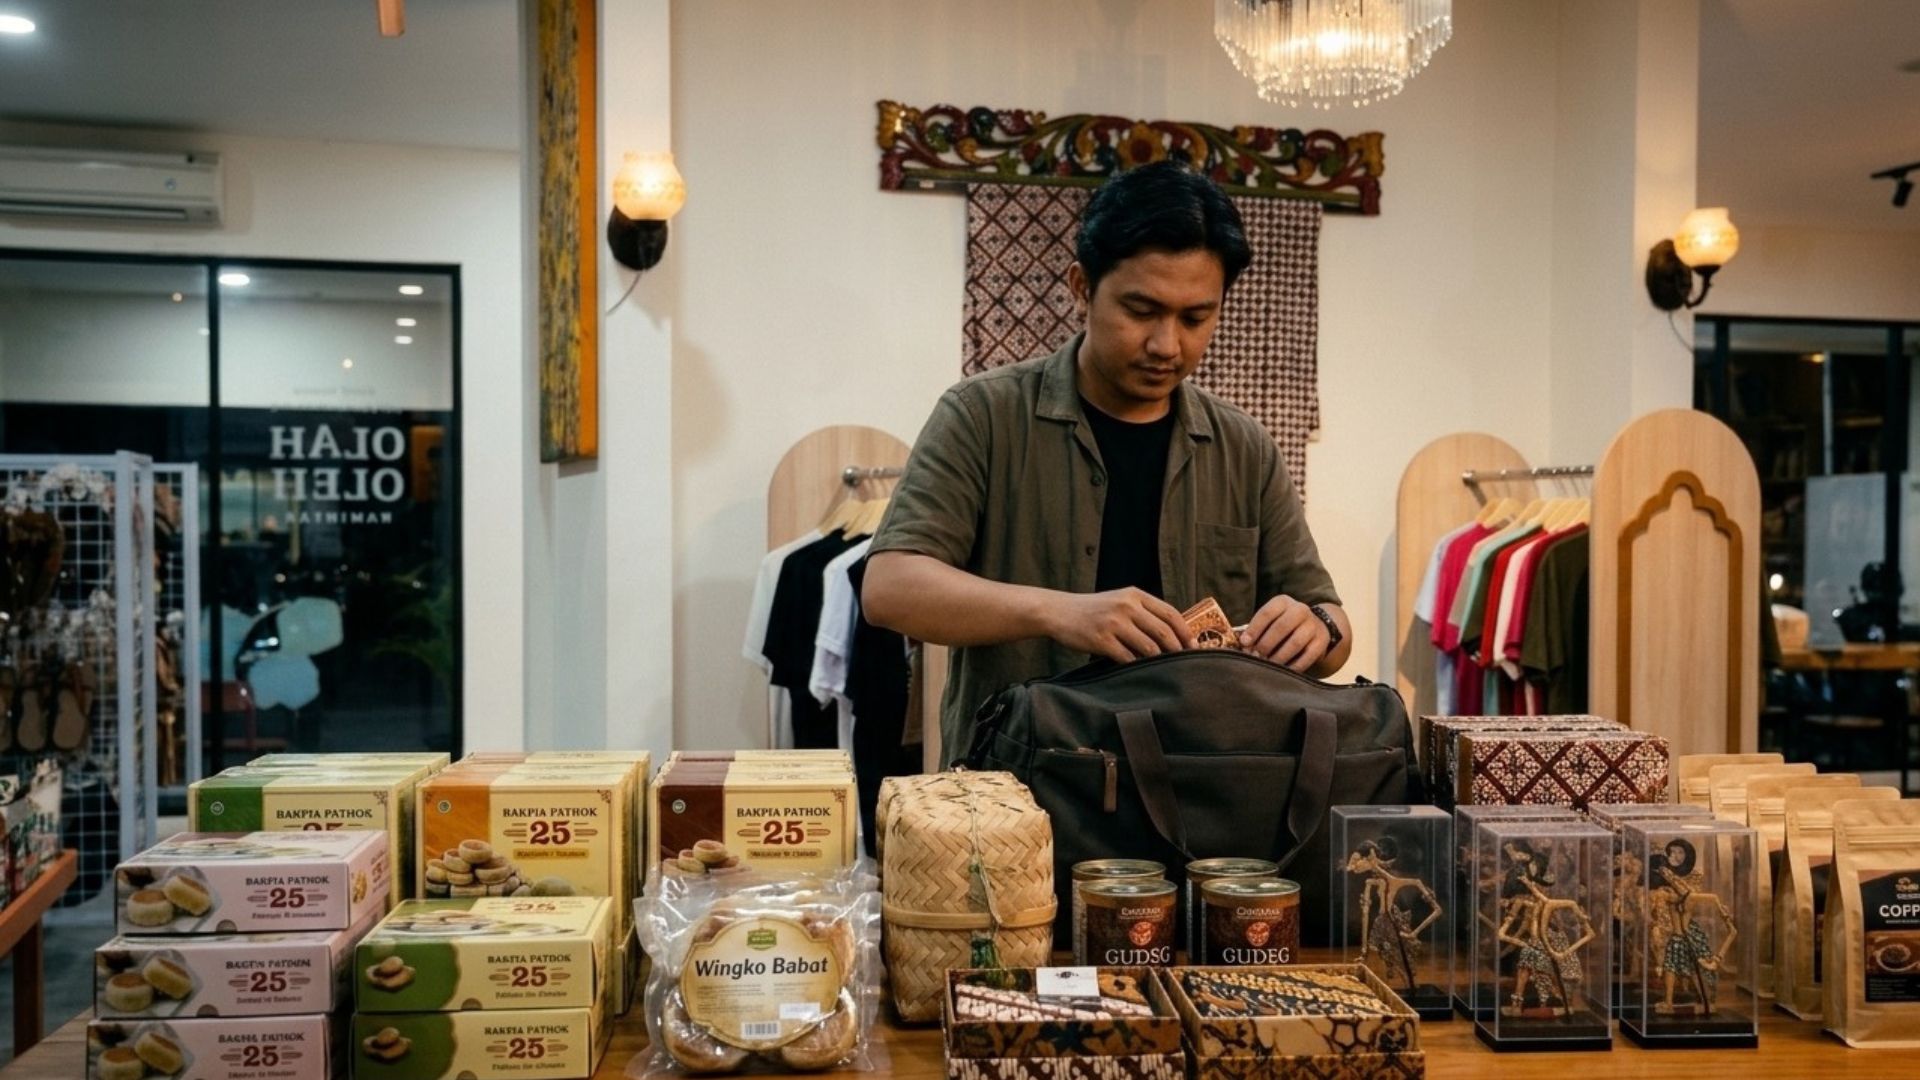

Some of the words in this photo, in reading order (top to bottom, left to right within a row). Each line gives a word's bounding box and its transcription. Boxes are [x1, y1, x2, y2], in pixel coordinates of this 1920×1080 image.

[324, 808, 373, 818] PATHOK
[783, 807, 831, 817] PATHOK
[529, 820, 571, 845] 25
[763, 820, 804, 845] 25
[269, 887, 305, 908] 25
[1222, 947, 1290, 965] GUDEG
[511, 966, 547, 988] 25
[695, 958, 766, 980] Wingko
[772, 956, 828, 974] Babat
[250, 971, 287, 992] 25
[243, 1045, 279, 1067] 25
[508, 1037, 545, 1059] 25
